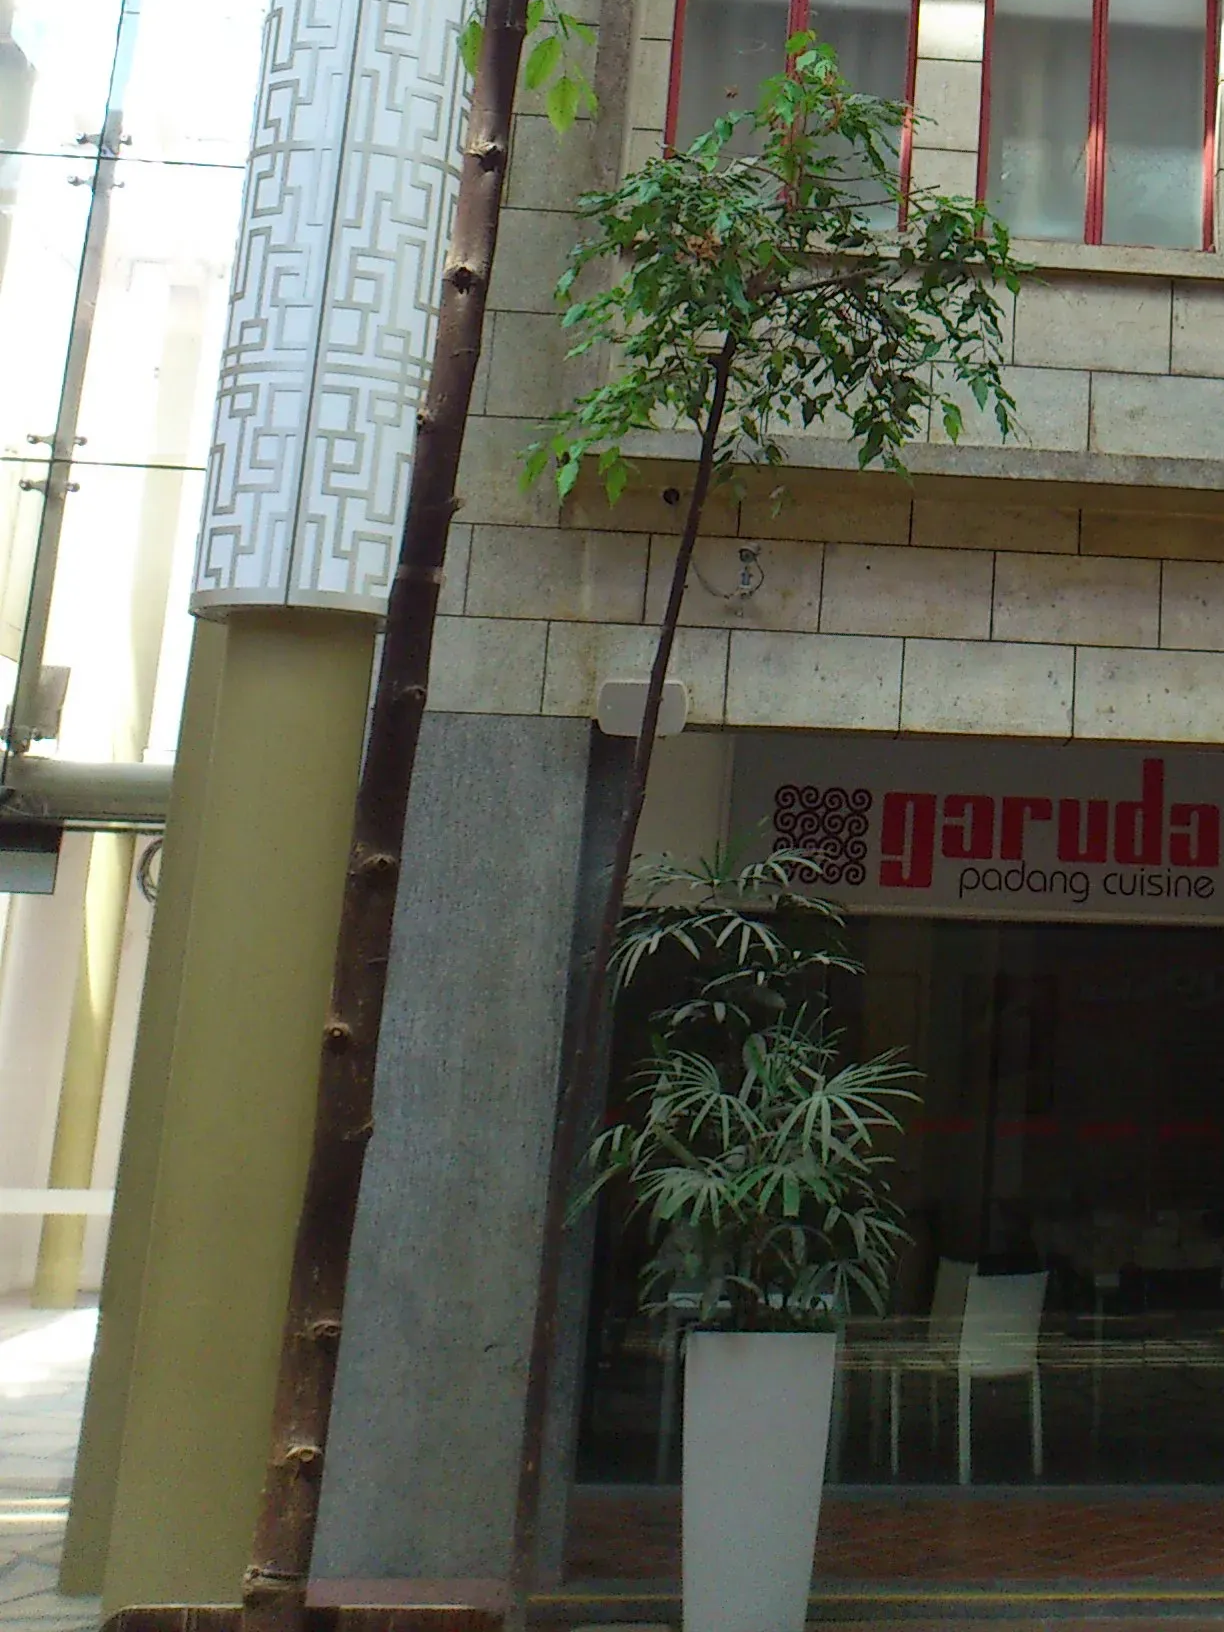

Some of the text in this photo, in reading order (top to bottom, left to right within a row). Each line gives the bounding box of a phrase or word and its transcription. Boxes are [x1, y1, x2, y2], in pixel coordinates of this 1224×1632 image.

[879, 758, 1220, 888] garuda
[959, 861, 1215, 902] padang cuisine
